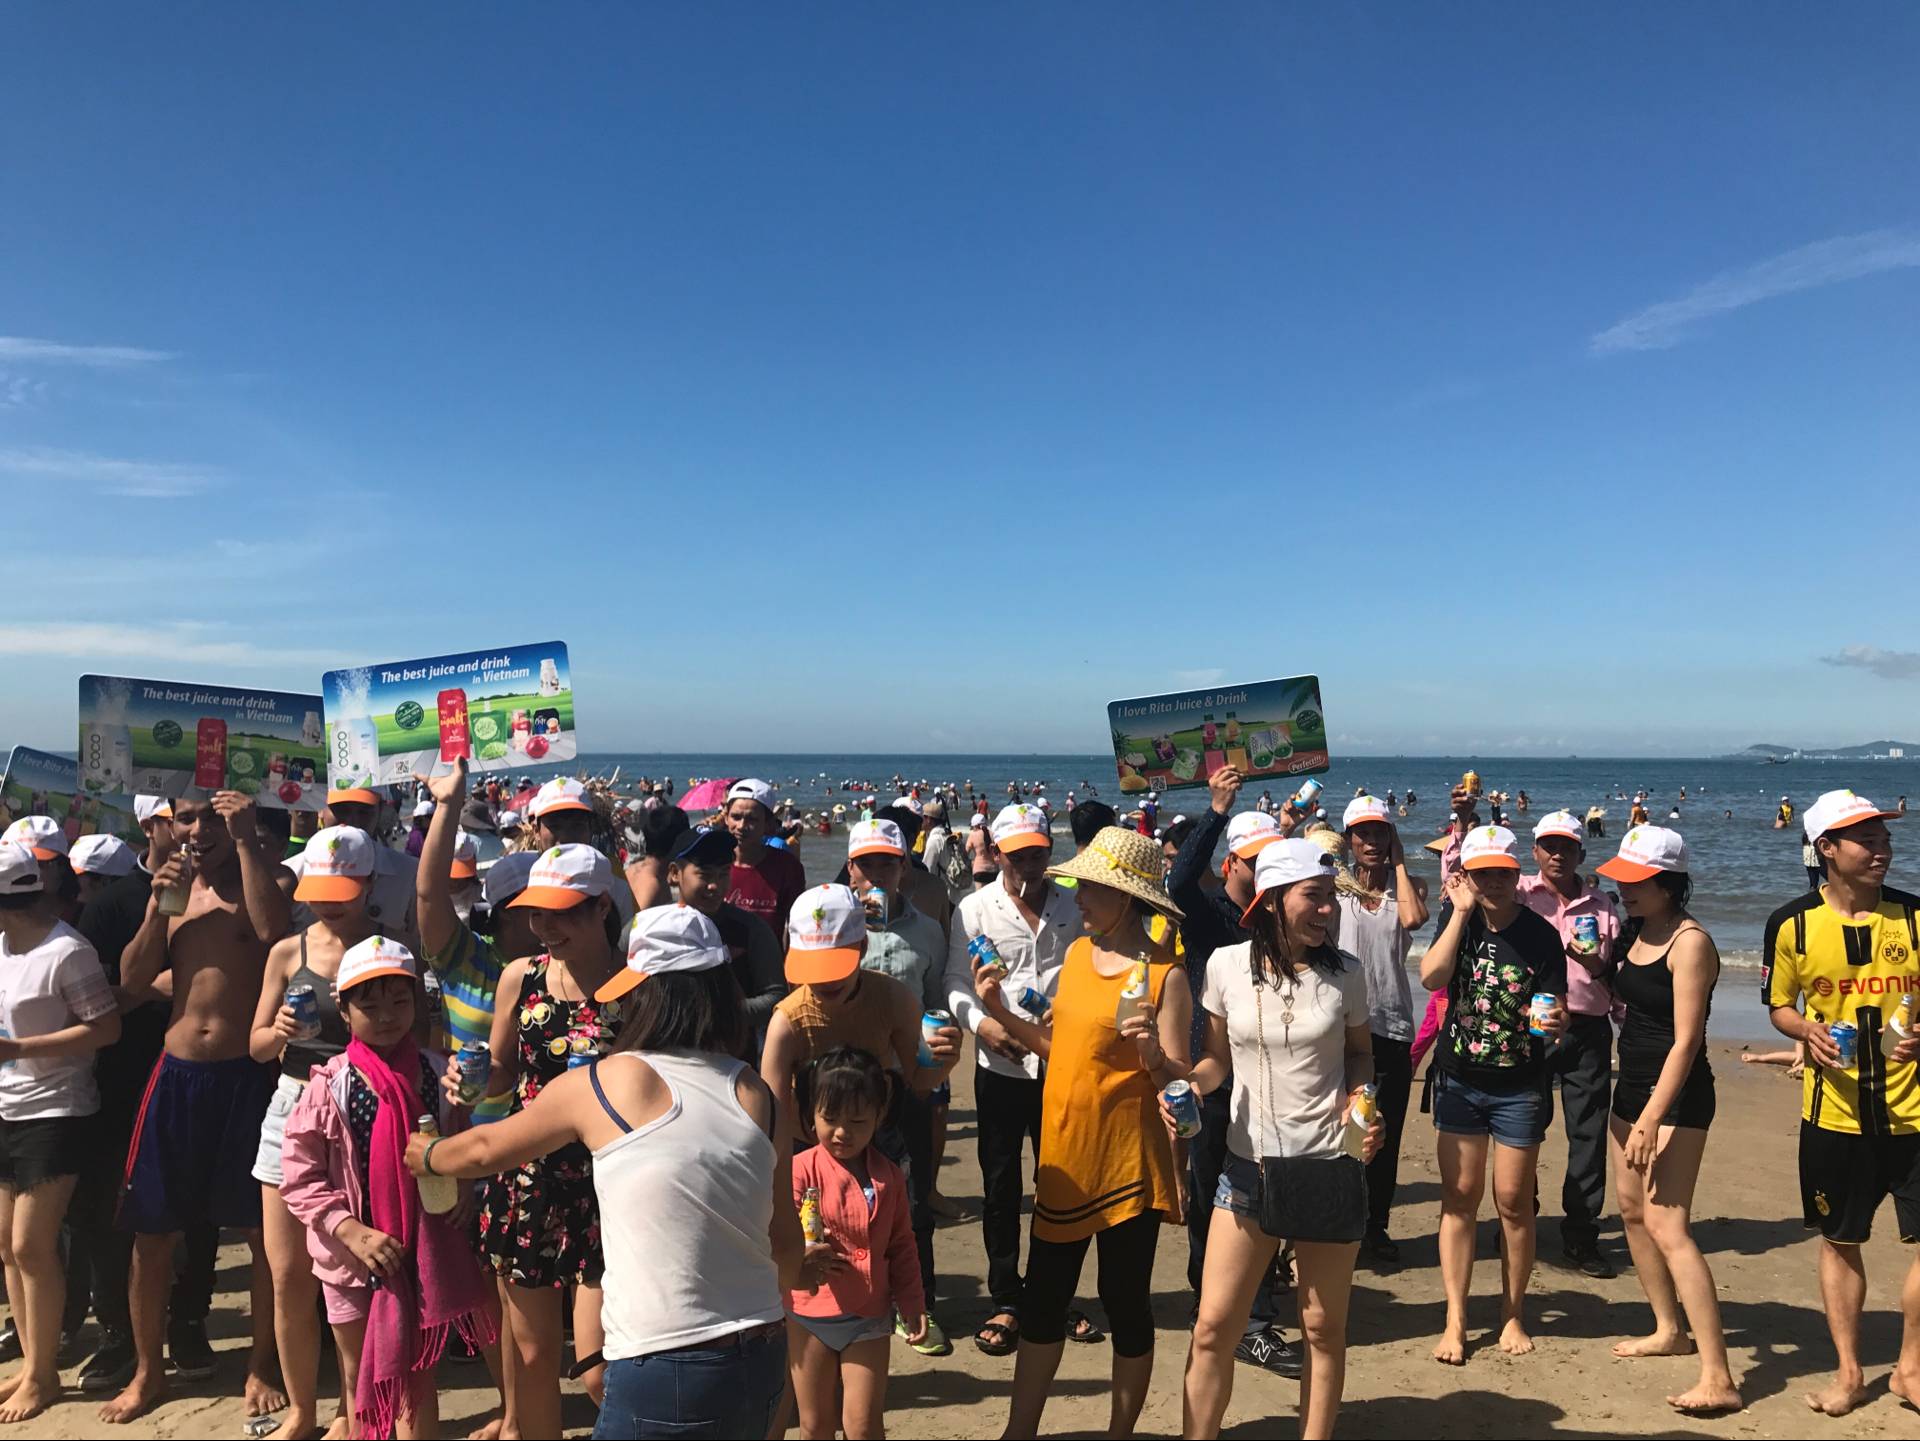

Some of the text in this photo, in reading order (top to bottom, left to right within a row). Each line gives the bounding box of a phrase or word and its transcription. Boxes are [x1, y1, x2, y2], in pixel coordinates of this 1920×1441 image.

[381, 655, 511, 684] The best juice and drink
[472, 667, 530, 685] in Vietnam
[143, 687, 276, 710] The best juice and drink
[1123, 706, 1147, 717] love
[1150, 702, 1172, 715] Rita
[1174, 698, 1202, 712] Juice
[1204, 696, 1214, 708] &
[1216, 691, 1248, 705] Drink
[235, 709, 293, 724] in Vietnam
